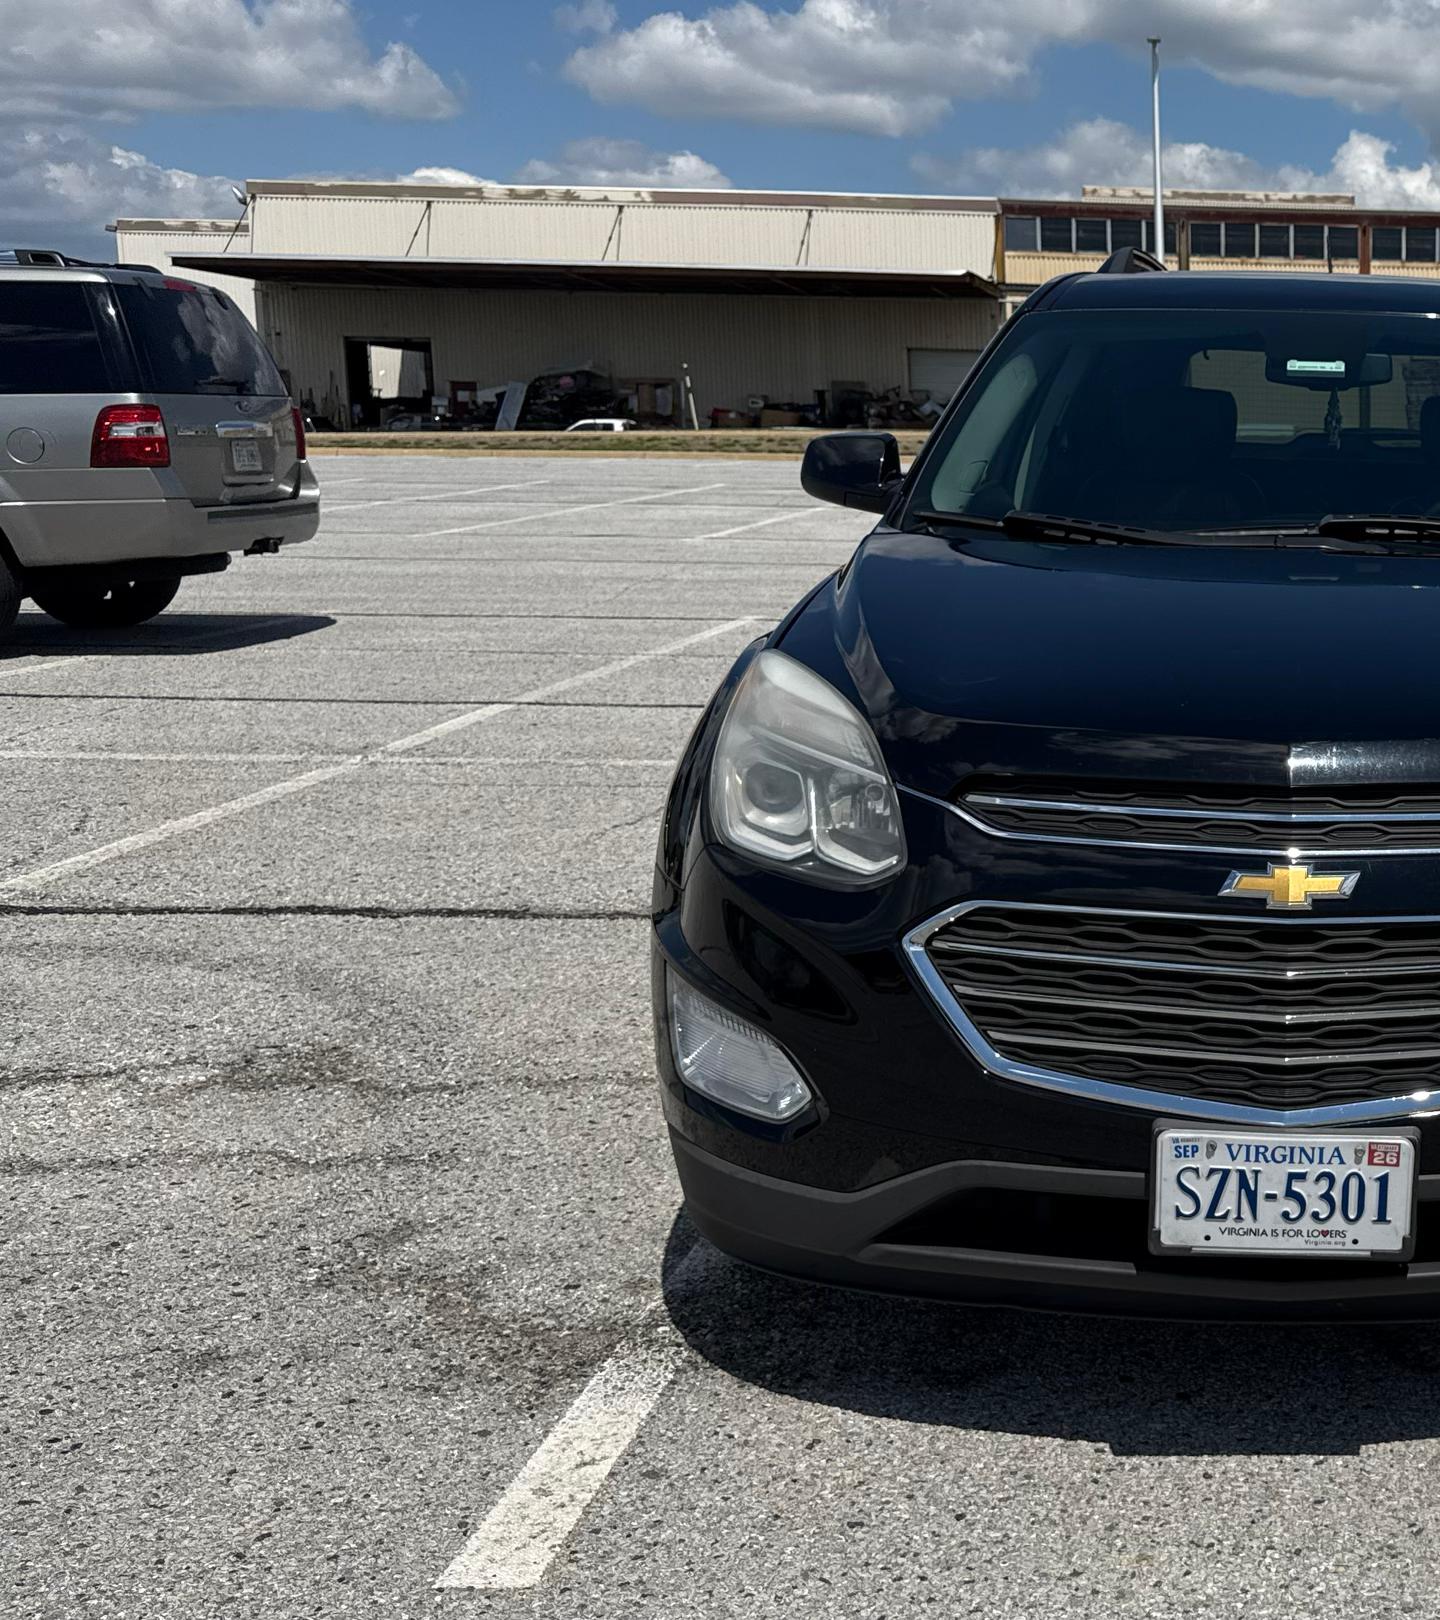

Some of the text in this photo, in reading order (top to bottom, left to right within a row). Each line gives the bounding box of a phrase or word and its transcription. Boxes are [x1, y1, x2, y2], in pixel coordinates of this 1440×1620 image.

[1175, 1144, 1199, 1158] SEP
[1225, 1143, 1346, 1165] VIRGINIA
[1373, 1151, 1398, 1165] 26
[1175, 1166, 1392, 1223] SZN-5301
[1219, 1227, 1268, 1237] VIRGINIA
[1271, 1228, 1279, 1237] IS
[1282, 1228, 1304, 1238] FOR
